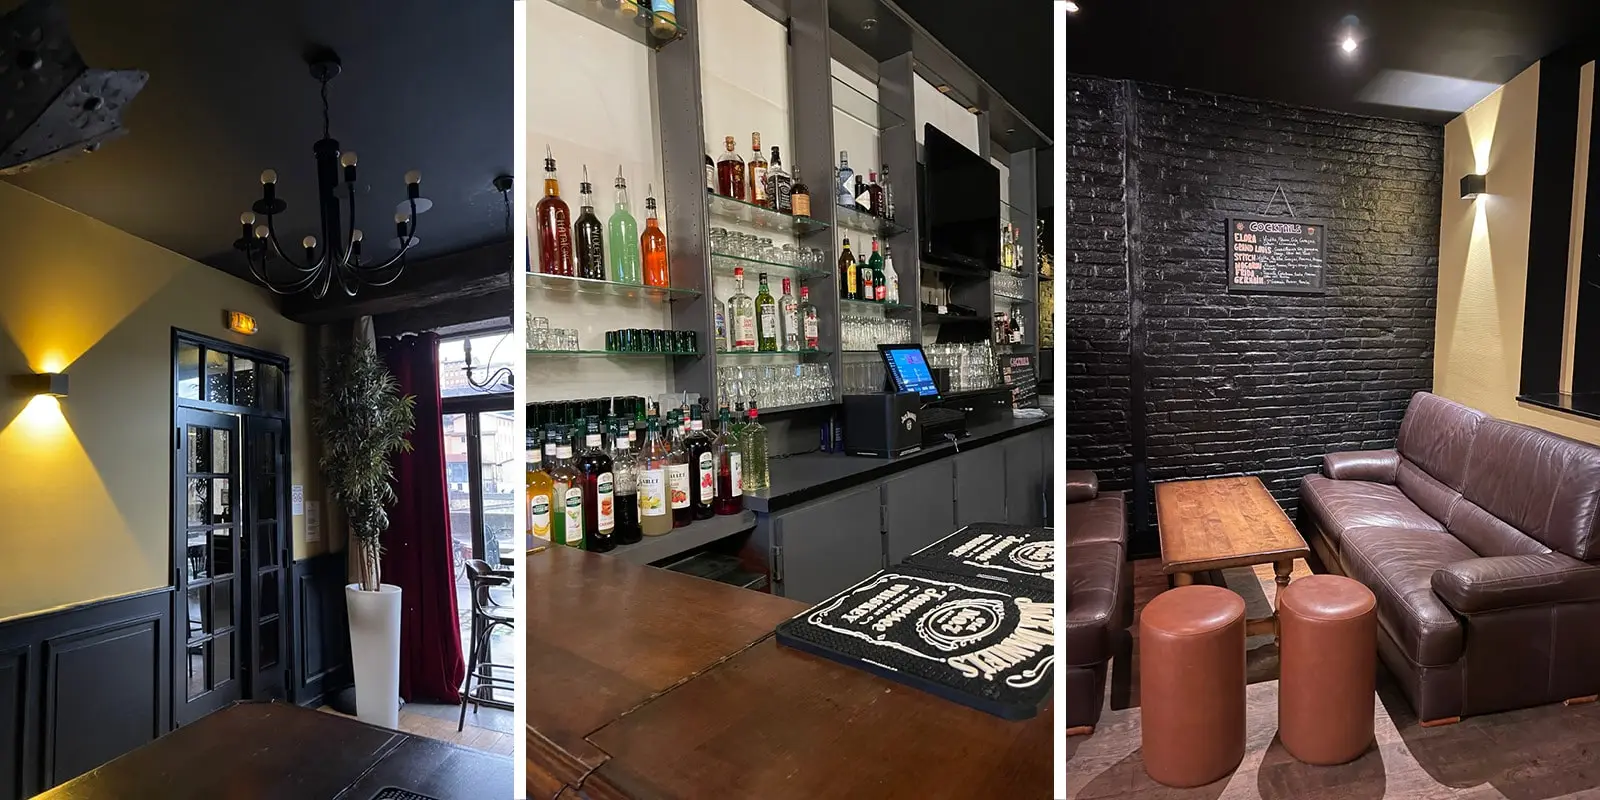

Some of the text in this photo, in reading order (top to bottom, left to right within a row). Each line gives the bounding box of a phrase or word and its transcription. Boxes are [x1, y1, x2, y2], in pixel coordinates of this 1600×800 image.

[1249, 222, 1302, 234] COCKTAILS
[1234, 232, 1257, 243] ELORA
[1233, 253, 1256, 262] STITCH
[841, 583, 910, 625] WHISKEY
